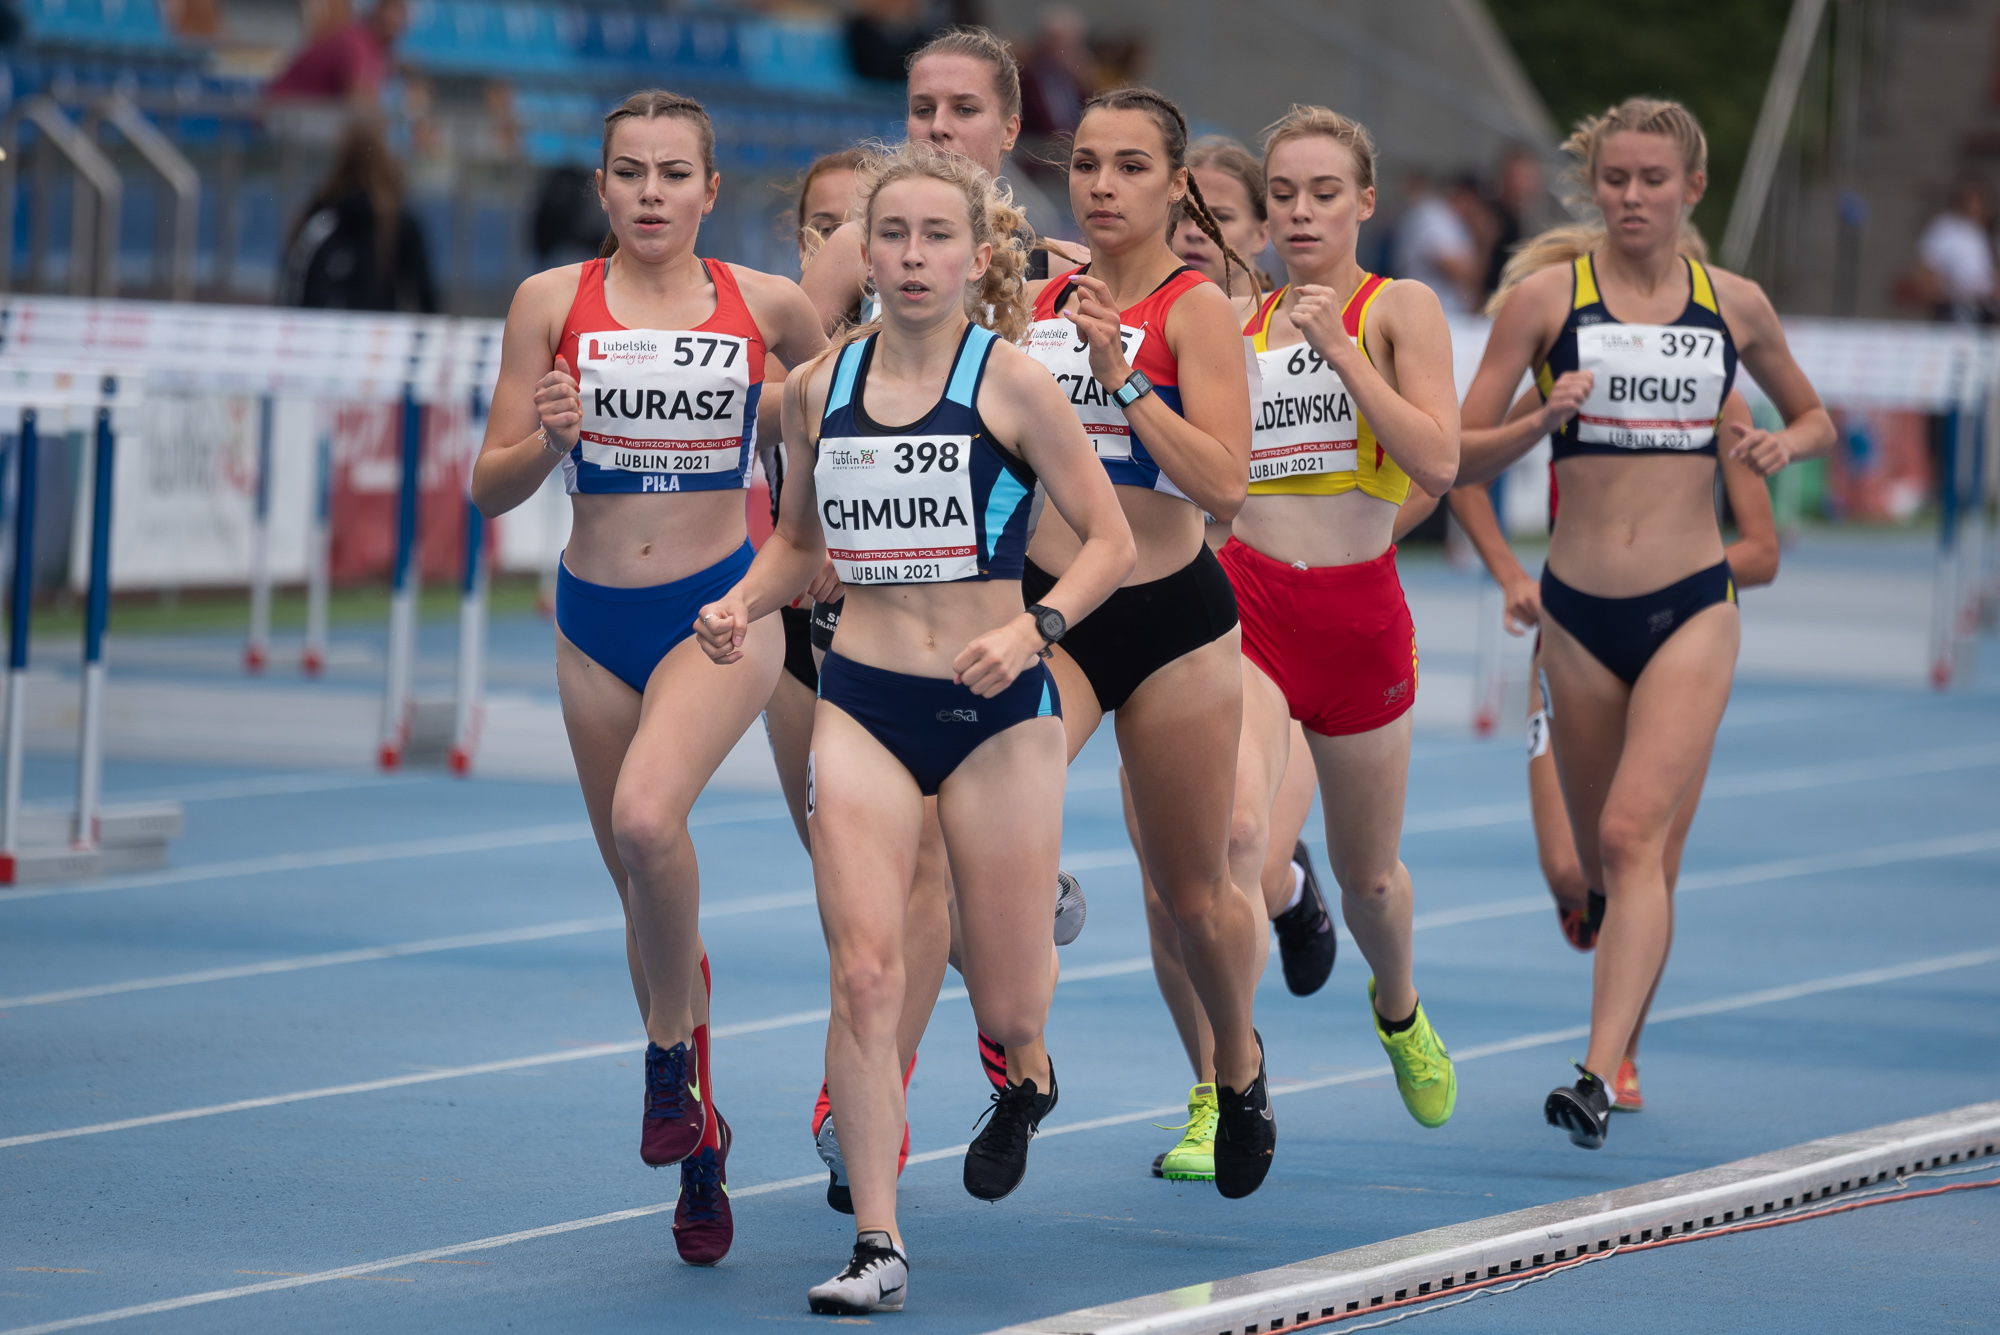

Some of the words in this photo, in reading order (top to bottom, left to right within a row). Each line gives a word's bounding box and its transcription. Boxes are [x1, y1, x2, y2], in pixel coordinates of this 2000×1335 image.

[673, 337, 740, 368] 577
[1661, 333, 1714, 358] 397
[1287, 347, 1336, 376] 69
[1609, 376, 1698, 405] BIGUS
[594, 387, 735, 421] KURASZ
[601, 436, 624, 445] PZLA
[625, 440, 690, 449] MISTRZOSTWA
[721, 439, 737, 447] U20
[1254, 446, 1302, 459] MISTRZOSTWA
[1303, 443, 1333, 451] POLSKI
[1334, 442, 1353, 450] U20
[1609, 431, 1655, 447] LUBLIN
[1661, 432, 1692, 448] 2021
[615, 452, 667, 469] LUBLIN
[673, 455, 710, 470] 2021
[893, 442, 960, 474] 398
[1250, 461, 1288, 480] LUBLIN
[1291, 457, 1324, 472] 2021
[642, 475, 680, 492] PIŁA
[823, 496, 968, 530] CHMURA
[855, 550, 917, 559] MISTRZOSTWA
[918, 549, 950, 557] POLSKI
[851, 566, 898, 581] LUBLIN
[904, 564, 940, 579] 2021
